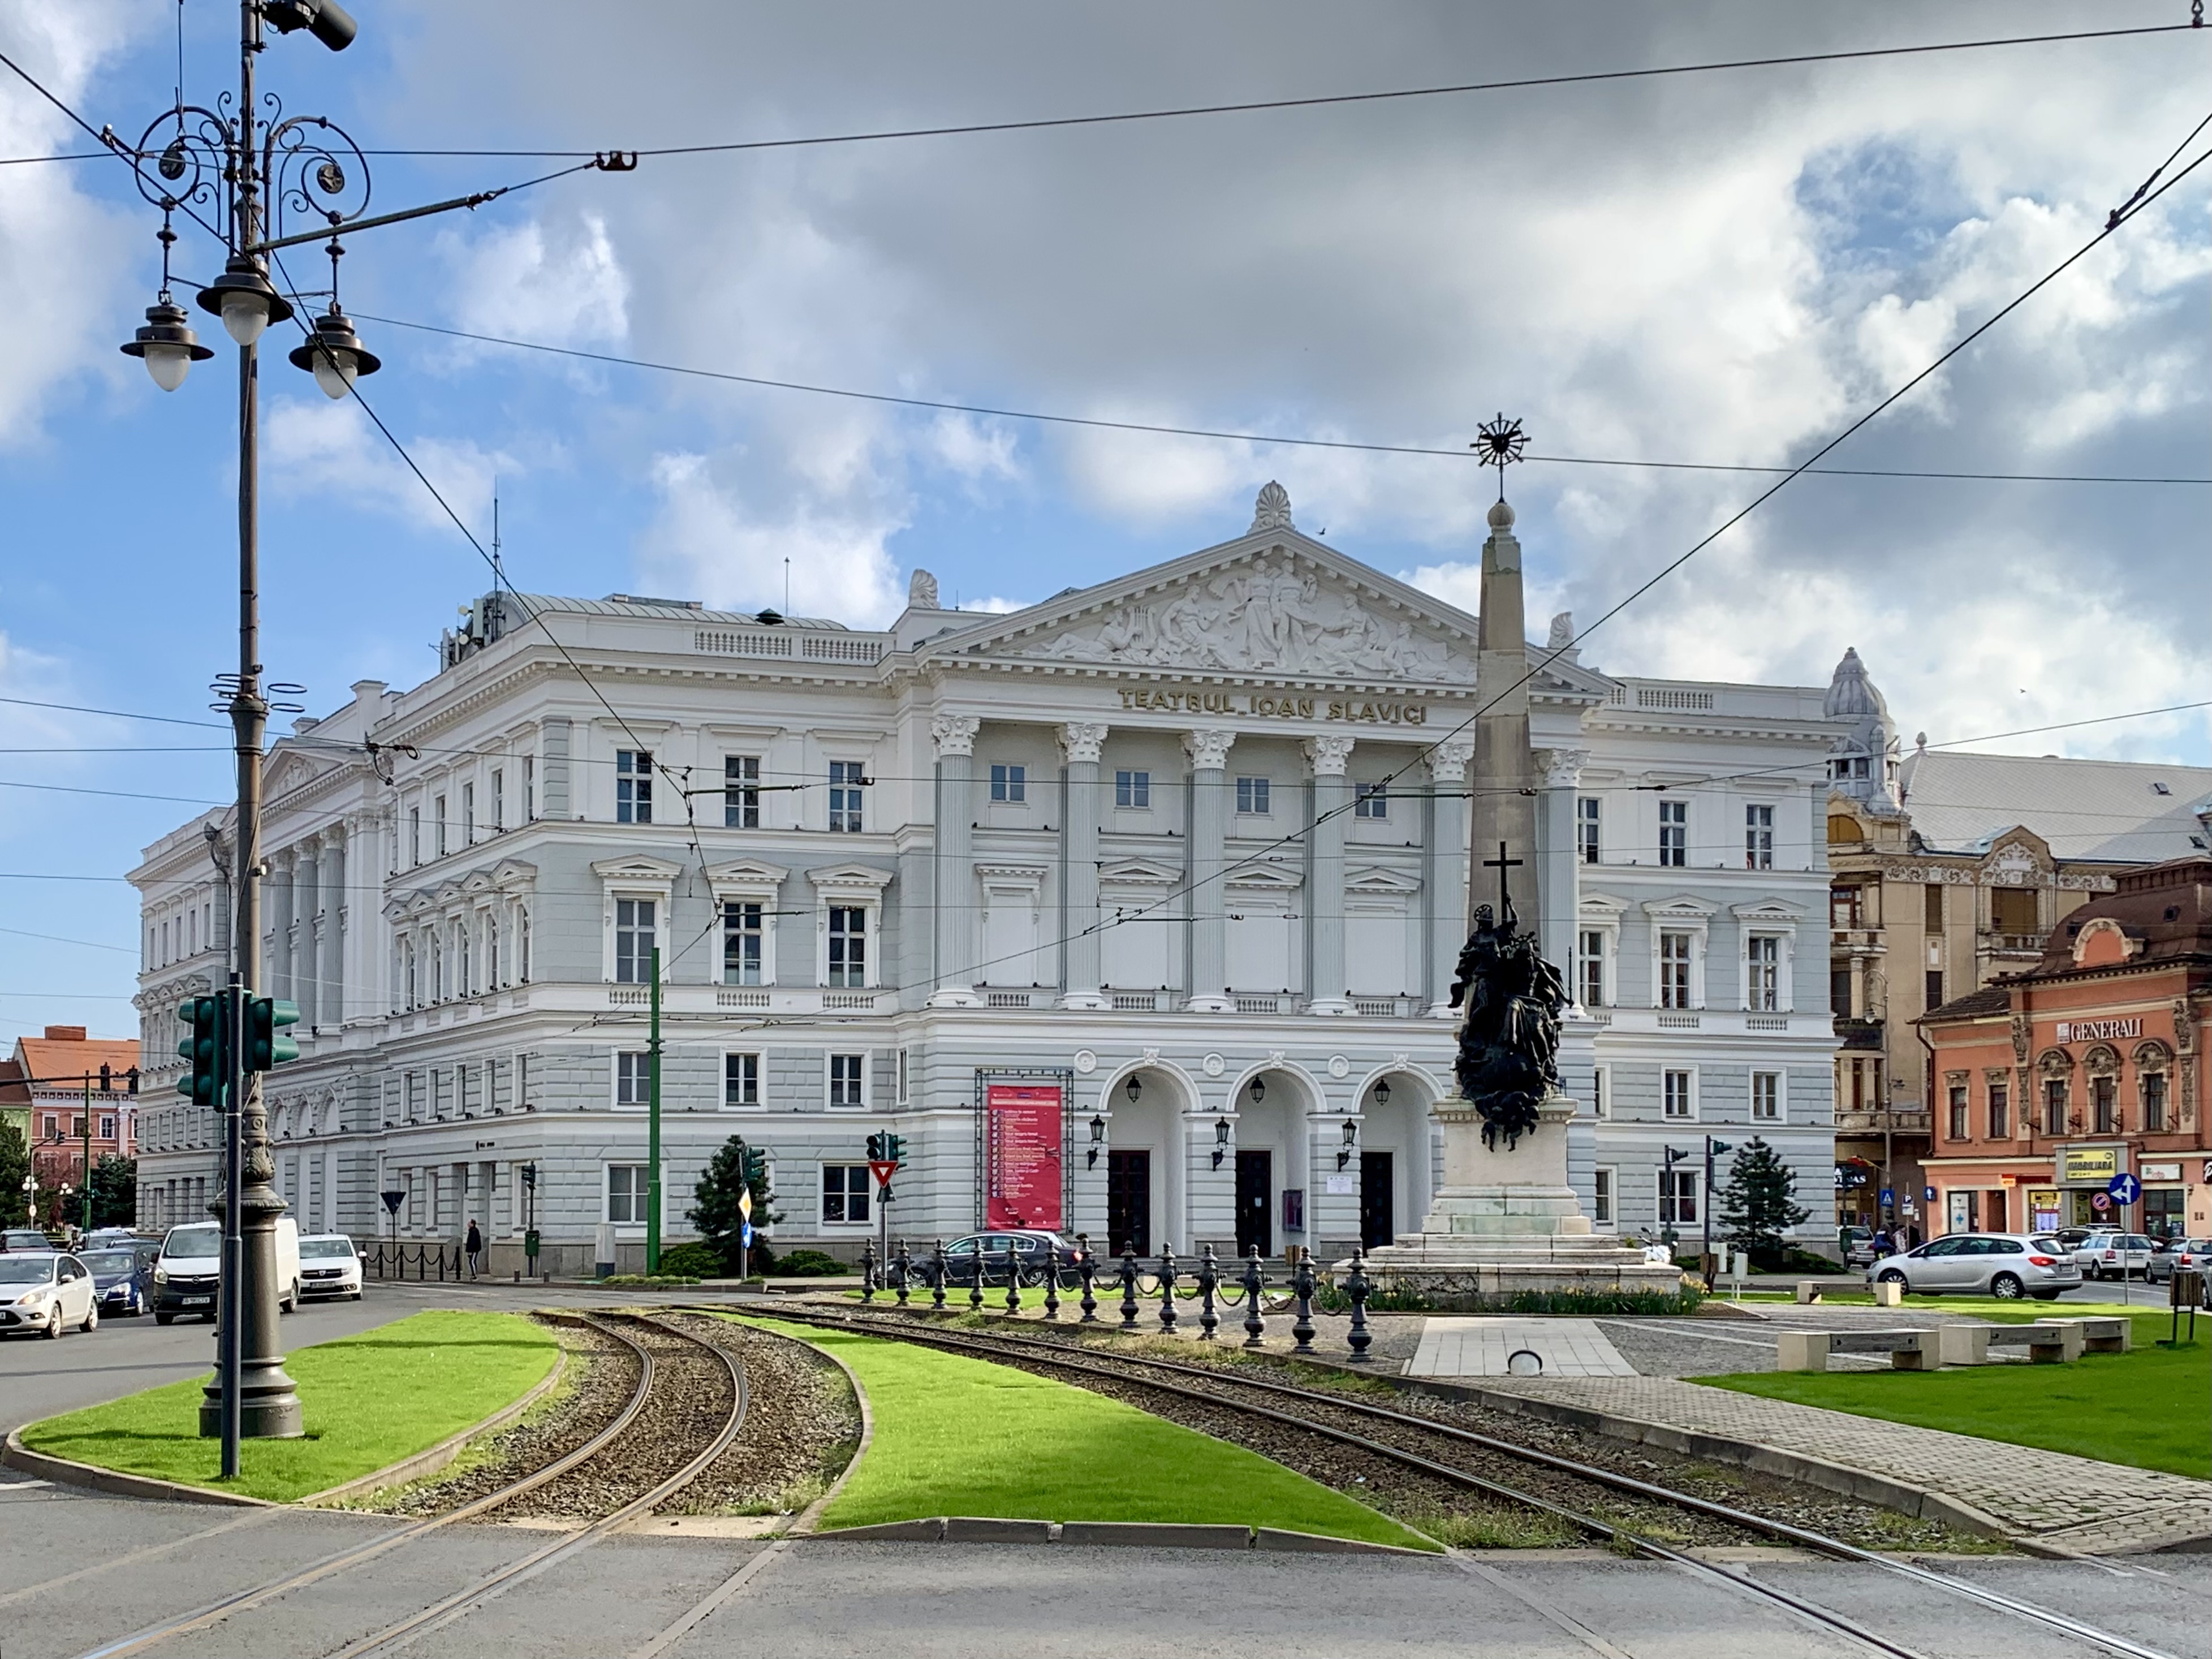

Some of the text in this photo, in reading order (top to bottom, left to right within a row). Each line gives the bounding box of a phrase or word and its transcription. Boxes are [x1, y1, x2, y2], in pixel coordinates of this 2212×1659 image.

[1118, 689, 1426, 722] TEATRUL IOAN SLAVICI
[2071, 1018, 2143, 1042] GENERALI
